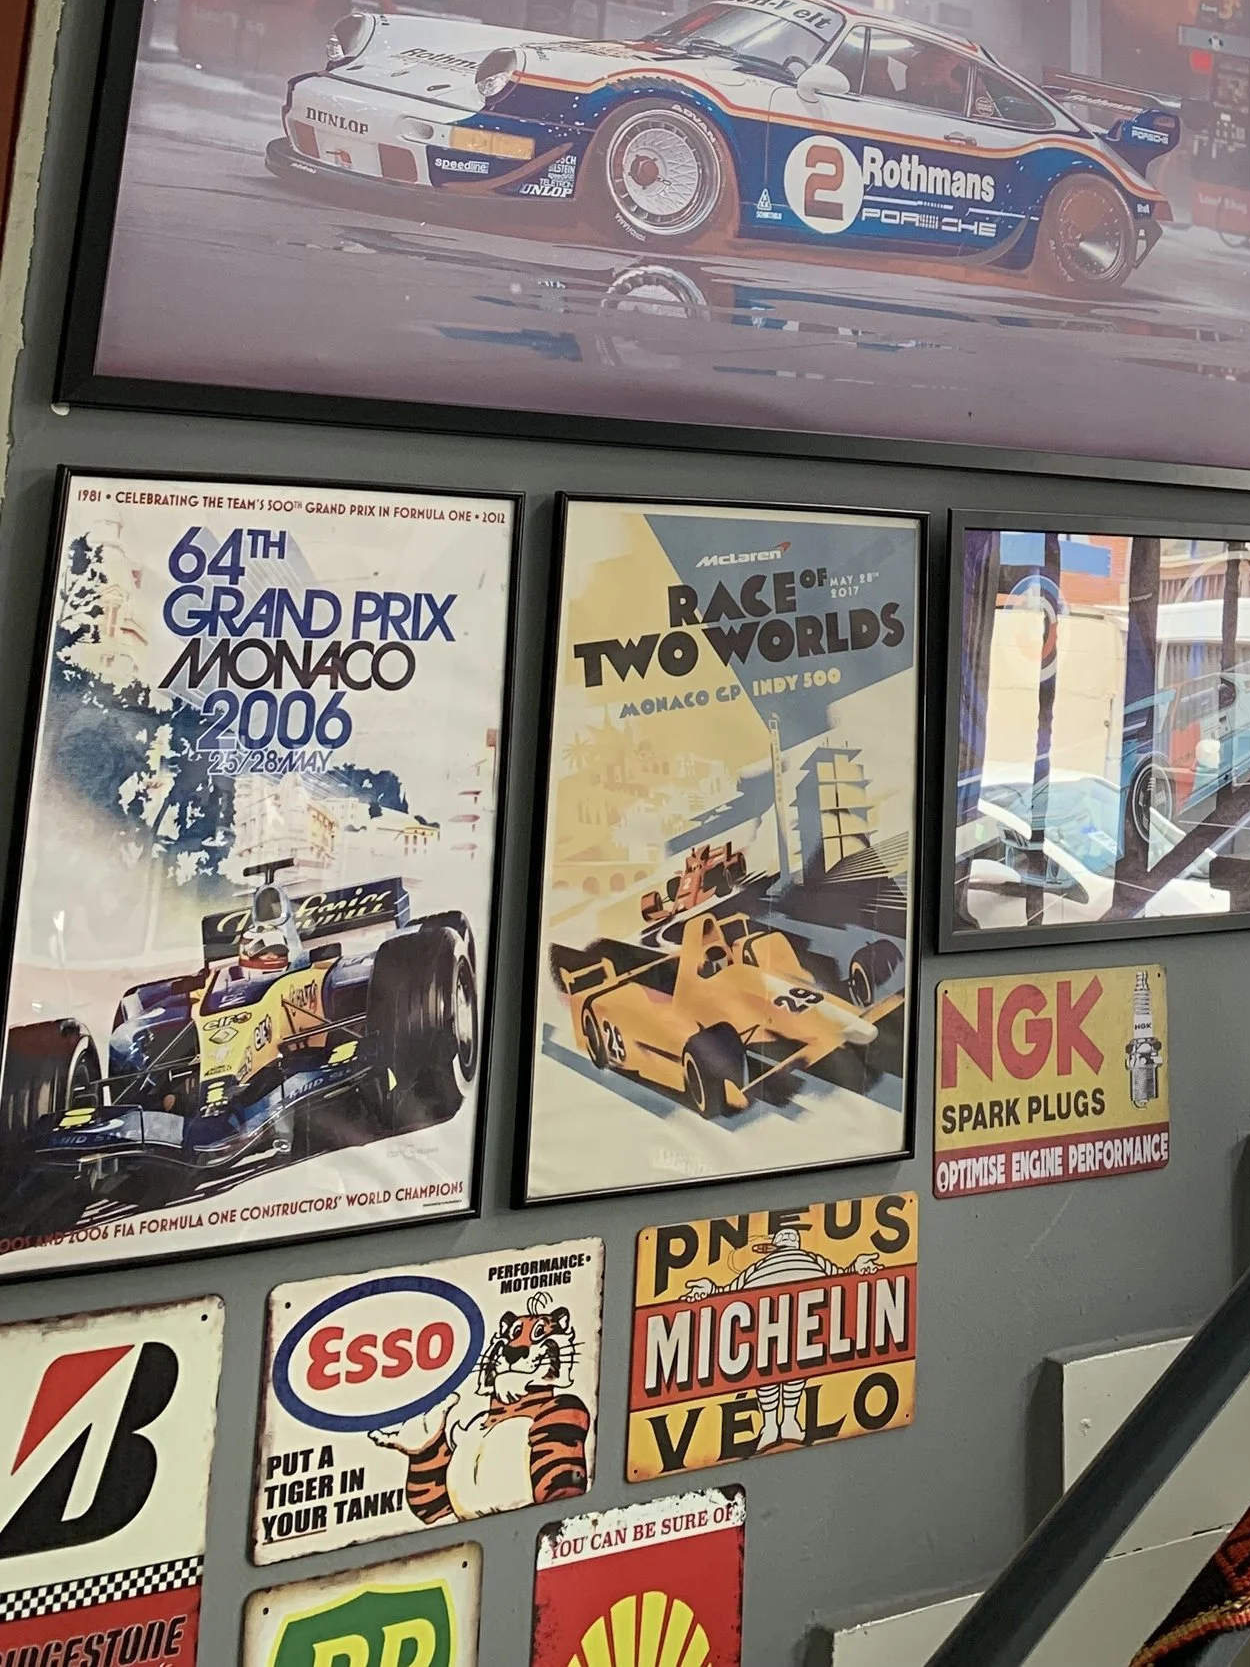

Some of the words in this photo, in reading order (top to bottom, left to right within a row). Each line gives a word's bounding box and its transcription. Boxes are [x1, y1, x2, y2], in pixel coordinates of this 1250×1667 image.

[306, 107, 369, 134] DUNLOP
[672, 104, 716, 143] ADVAN
[434, 157, 489, 174] speedline
[804, 144, 844, 220] 2
[862, 146, 995, 202] Rothmans
[77, 489, 102, 502] 1981
[115, 491, 199, 508] CELEBRATING
[202, 495, 224, 509] THE
[227, 497, 264, 511] TEAM'S
[267, 499, 302, 513] 500TH
[305, 502, 346, 516] GRAND
[349, 504, 376, 518] PRIX
[378, 506, 390, 518] IN
[393, 506, 445, 521] FORMULA
[448, 509, 472, 522] ONE
[482, 512, 506, 524] 2012
[168, 526, 287, 585] 64TH
[695, 549, 782, 568] McLaren
[163, 585, 342, 639] GRAND
[351, 591, 457, 642] PRIX
[667, 572, 797, 628] RACE
[799, 567, 828, 589] OF
[830, 575, 853, 587] MAY
[831, 587, 859, 598] 2017
[158, 638, 416, 691] MONACO
[573, 630, 699, 688] TWO
[701, 602, 905, 666] WORLDS
[619, 690, 710, 719] MONACO
[716, 684, 741, 703] GP
[752, 674, 798, 697] INDY
[803, 667, 841, 689] 500
[197, 690, 354, 751] 2006
[773, 987, 824, 1013] 29
[1134, 1022, 1152, 1031] NGK
[940, 974, 1105, 1089] NGK
[941, 1097, 1020, 1135] SPARK
[1028, 1088, 1105, 1124] PLUGS
[936, 1153, 1006, 1193] OPTIMISE
[1011, 1146, 1063, 1182] ENGINE
[1068, 1132, 1169, 1175] PERFORMANCE
[34, 1231, 63, 1248] AND
[67, 1226, 109, 1244] 2006
[114, 1222, 135, 1238] FIA
[139, 1214, 204, 1235] FORMULA
[208, 1209, 236, 1225] ONE
[240, 1196, 342, 1222] CONSTRUCTORS'
[346, 1189, 392, 1207] WORLD
[396, 1180, 464, 1202] CHAMPIONS
[488, 1253, 585, 1282] PERFORMANCE
[654, 1194, 911, 1298] PNEUS
[500, 1270, 572, 1295] MOTORING
[306, 1321, 455, 1392] ESSO
[645, 1275, 909, 1398] MICHELIN
[265, 1474, 334, 1511] TIGER
[340, 1467, 365, 1492] IN
[266, 1448, 315, 1481] PUT
[317, 1445, 335, 1470] A
[262, 1500, 327, 1541] YOUR
[335, 1488, 404, 1526] TANK!
[551, 1538, 584, 1560] YOU
[590, 1527, 628, 1551] CAN
[632, 1522, 656, 1542] BE
[660, 1510, 708, 1536] SURE
[713, 1506, 734, 1524] OF
